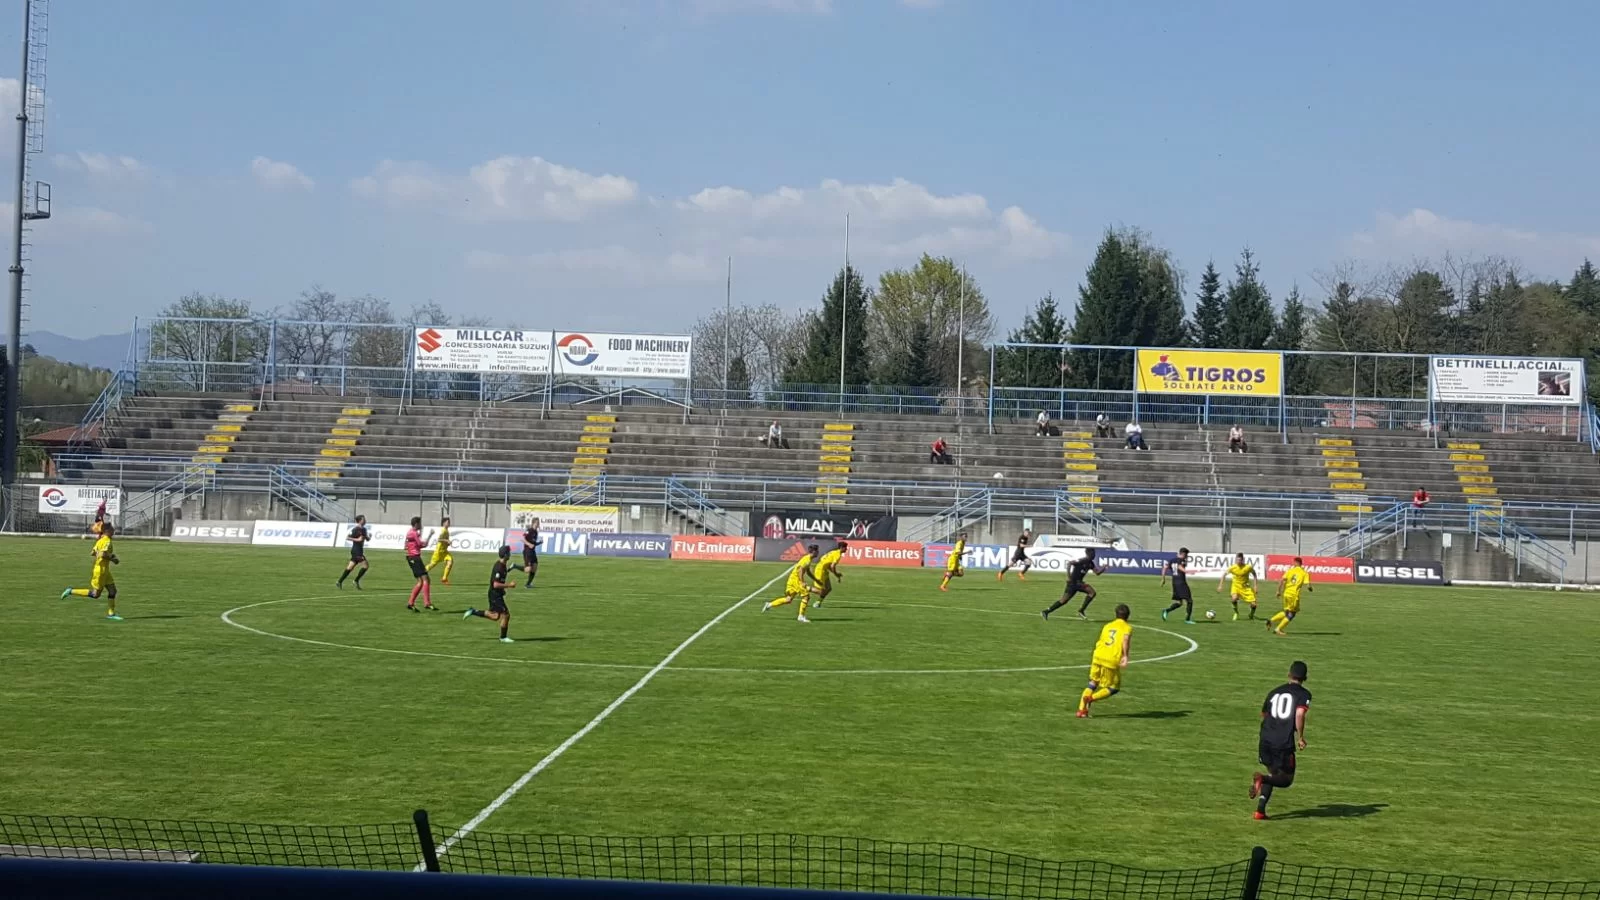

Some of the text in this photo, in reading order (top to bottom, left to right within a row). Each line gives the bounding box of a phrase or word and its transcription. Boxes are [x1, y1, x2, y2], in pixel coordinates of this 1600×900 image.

[456, 330, 524, 342] MILLCAR
[608, 338, 690, 353] FOOD MACHINERY
[416, 362, 479, 370] www.millcar.it
[1186, 366, 1265, 383] TIGROS
[1164, 381, 1253, 391] SOLBIATE ARNO
[785, 517, 834, 532] MILAN
[174, 526, 250, 538] DIESEL
[294, 529, 333, 539] TIRES
[374, 531, 405, 541] Group
[474, 539, 501, 550] BPM
[538, 532, 587, 553] TIM
[593, 540, 666, 551] NIVEA MEN
[674, 540, 752, 554] Fly Emirates
[864, 546, 920, 560] Emirates
[1099, 557, 1140, 568] NIVEA
[1186, 555, 1260, 568] PREMIM
[1268, 563, 1352, 574] FREIAROSSA
[1358, 565, 1441, 579] DIESEL
[1104, 629, 1117, 646] 3
[1270, 692, 1294, 720] 10
